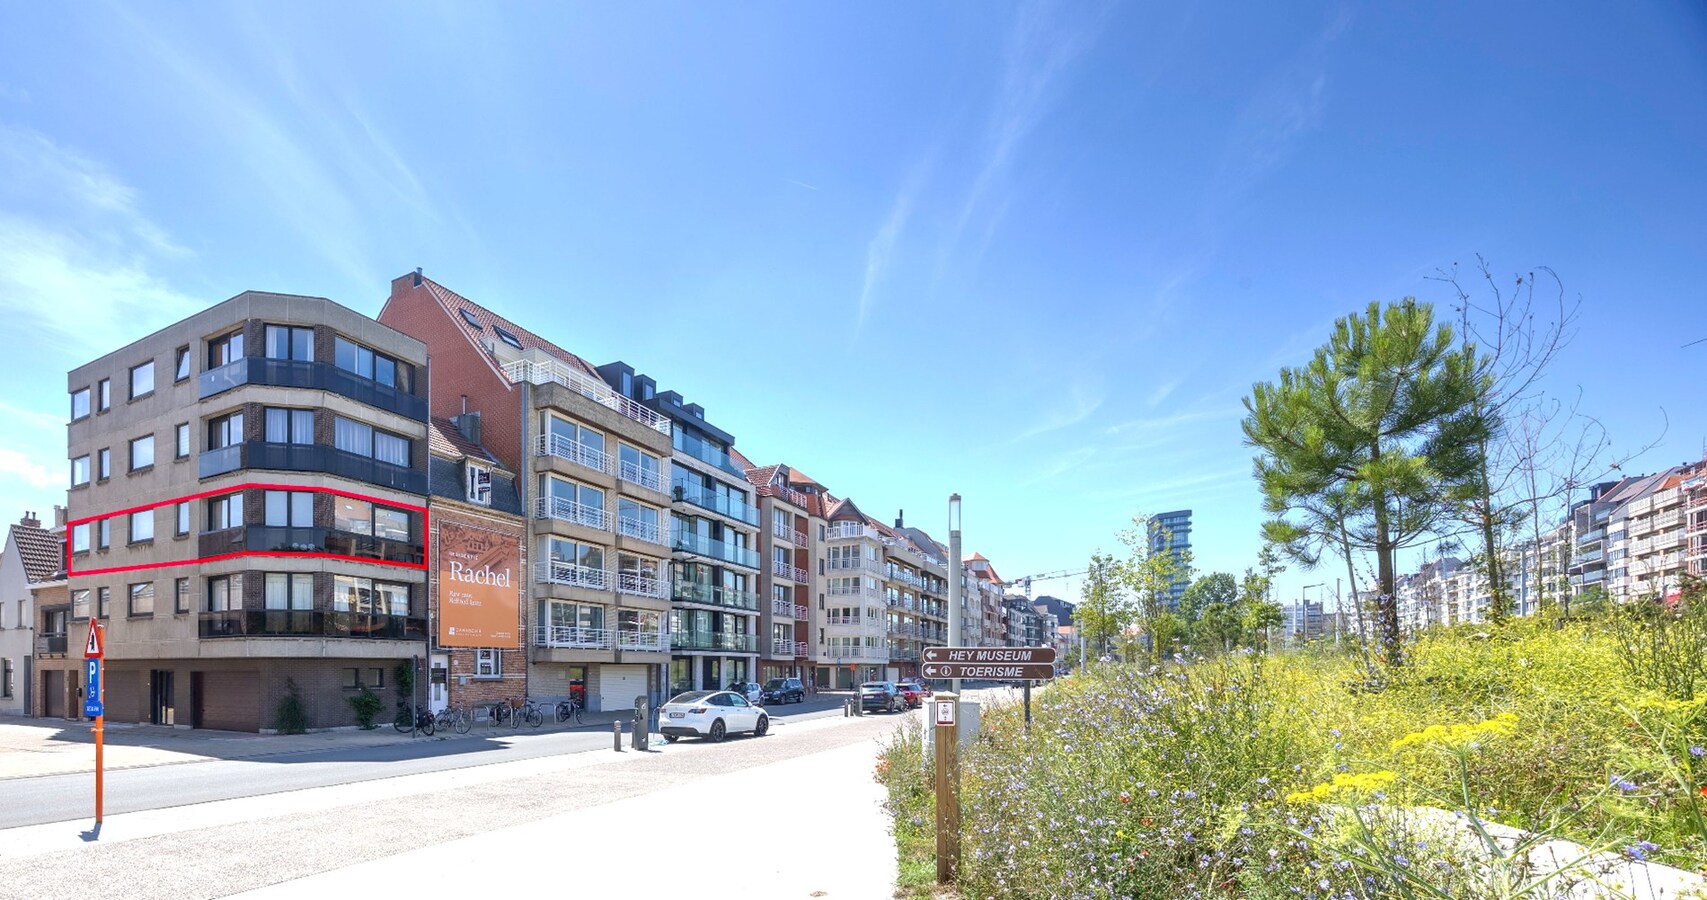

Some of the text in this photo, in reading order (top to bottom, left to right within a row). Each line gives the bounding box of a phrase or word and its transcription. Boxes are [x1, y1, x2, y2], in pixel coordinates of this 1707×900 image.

[449, 560, 511, 588] Rachel
[949, 651, 1032, 661] HEY MUSEUM
[89, 661, 96, 683] P
[960, 666, 1024, 677] TOERISME
